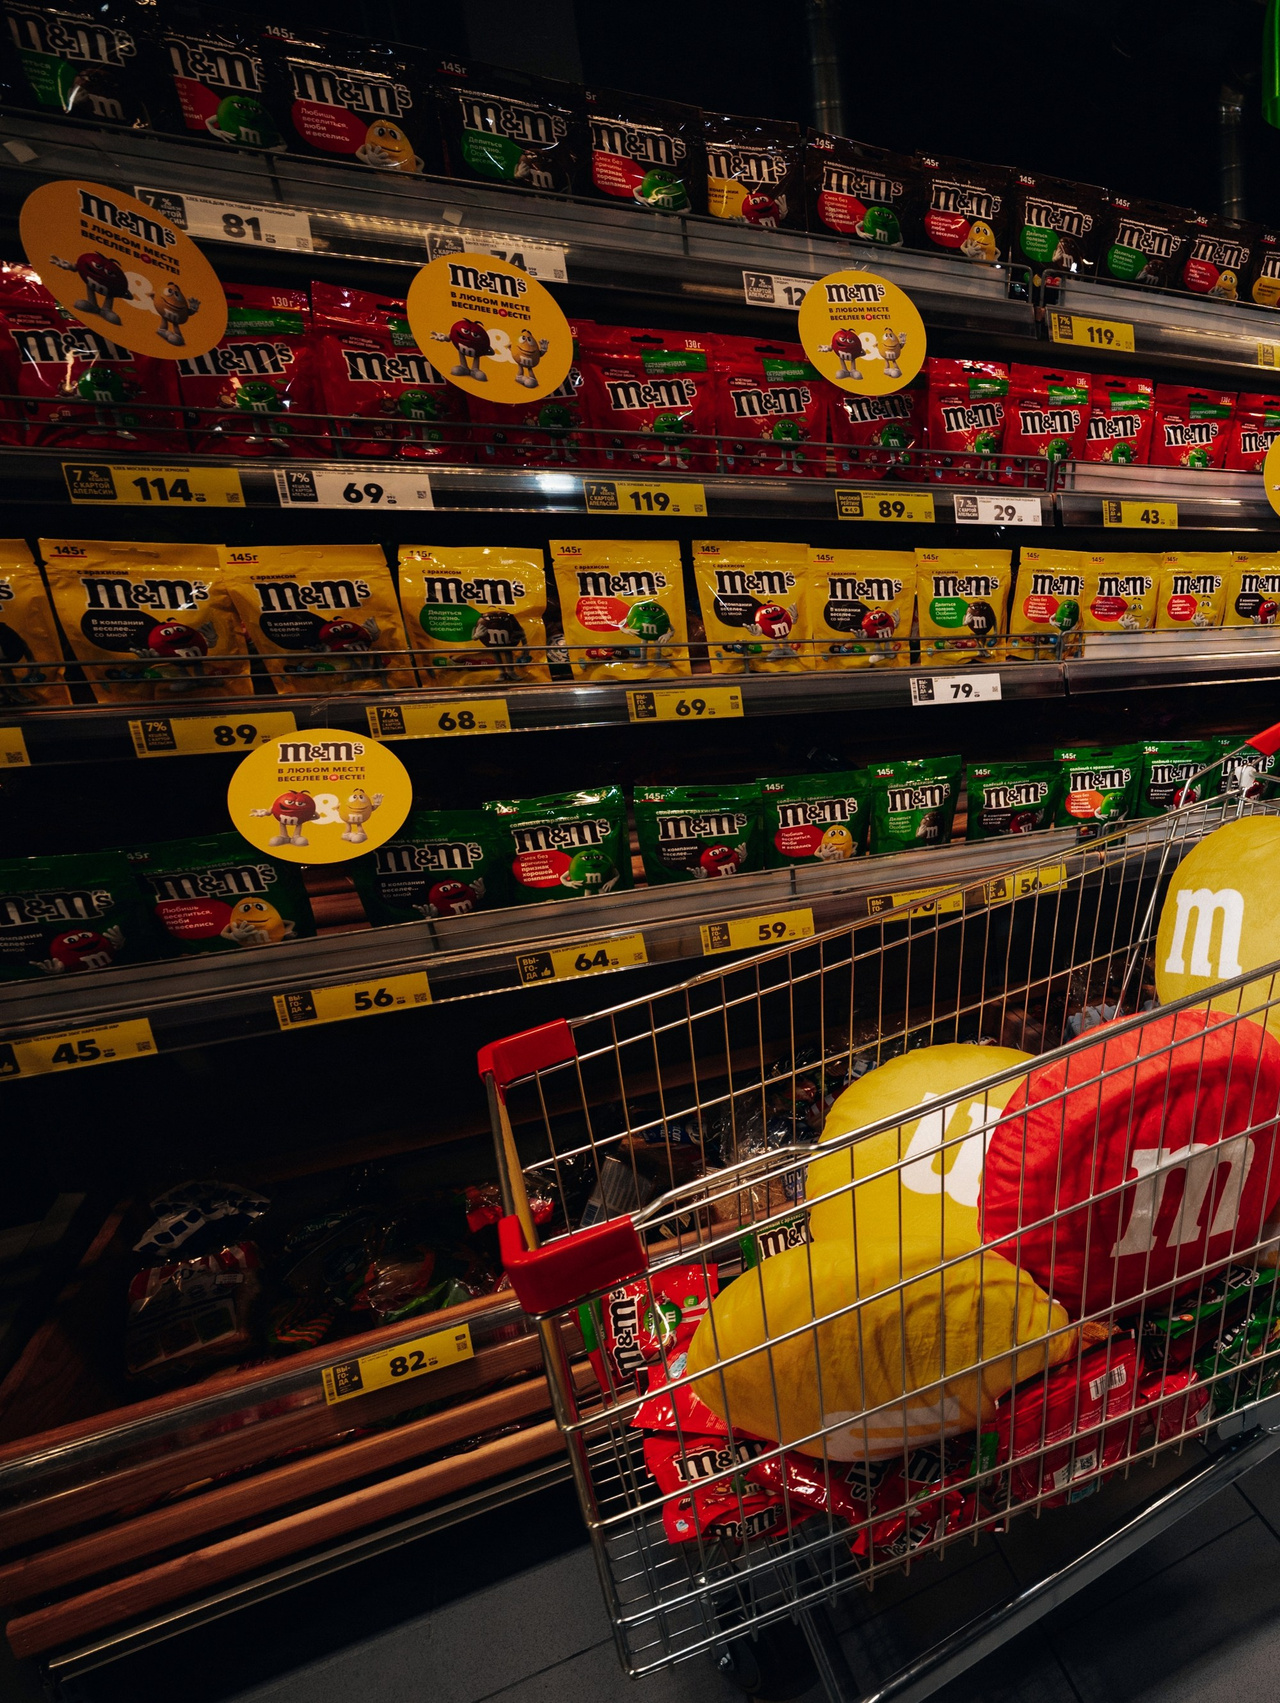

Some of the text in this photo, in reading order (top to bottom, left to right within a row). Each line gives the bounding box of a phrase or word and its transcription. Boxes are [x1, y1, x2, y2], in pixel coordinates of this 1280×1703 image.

[265, 25, 295, 40] 145г
[441, 60, 467, 75] 145г
[288, 62, 413, 118] m&m's
[301, 108, 336, 120] Любишь
[459, 95, 567, 145] m&m's
[304, 122, 328, 133] люби
[313, 131, 350, 142] веселись
[468, 136, 503, 149] Делиться
[589, 119, 687, 167] m&m's
[822, 166, 903, 203] m&m's
[1019, 174, 1036, 186] 145г
[930, 184, 1002, 220] m&m's
[1114, 198, 1131, 209] 145г
[78, 188, 177, 249] m&m's
[222, 213, 262, 241] 81
[1025, 201, 1094, 238] m&m's
[81, 229, 132, 256] ВЕСЕЛЕЕ
[91, 224, 142, 250] ЛЮБОМ
[144, 245, 180, 267] МЕСТЕ
[1115, 222, 1183, 259] m&m's
[1190, 239, 1250, 269] m&m's
[448, 263, 527, 299] m&m's
[460, 293, 499, 307] ЛЮБОМ
[501, 300, 531, 313] МЕСТЕ
[824, 283, 886, 304] m&m's
[451, 300, 491, 314] ВЕСЕЛЕЕ
[1087, 326, 1114, 345] 119
[606, 378, 697, 410] m&m's
[731, 387, 811, 418] m&m's
[844, 396, 914, 423] m&m's
[942, 402, 1003, 433] m&m's
[1018, 409, 1081, 435] m&m's
[1164, 422, 1218, 447] m&m's
[72, 470, 99, 481] 7 %
[79, 481, 110, 489] КАРТОЙ
[289, 472, 310, 483] 7%
[132, 477, 193, 501] 114
[343, 483, 384, 503] 69
[629, 491, 670, 511] 119
[879, 500, 905, 518] 89
[993, 504, 1016, 521] 29
[1140, 510, 1160, 525] 43
[54, 546, 86, 556] 145г
[230, 553, 258, 562] 145г
[560, 546, 581, 554] 145г
[423, 576, 526, 606] m&m's
[576, 571, 666, 597] m&m's
[714, 570, 796, 595] m&m's
[827, 577, 902, 601] m&m's
[932, 574, 998, 598] m&m's
[1098, 576, 1152, 597] m&m's
[1172, 574, 1221, 595] m&m's
[80, 578, 209, 610] m&m's
[254, 579, 371, 612] m&m's
[950, 683, 973, 698] 79
[380, 708, 398, 718] 7%
[675, 699, 706, 716] 69
[146, 721, 167, 732] 7%
[438, 710, 476, 731] 68
[213, 724, 257, 746] 89
[277, 741, 365, 763] m&m's
[1061, 752, 1076, 760] 145г
[974, 768, 991, 776] 145г
[1070, 768, 1131, 793] m&m's
[887, 782, 950, 813] m&m's
[983, 782, 1048, 811] m&m's
[777, 798, 857, 829] m&m's
[511, 818, 611, 854] m&m's
[657, 813, 747, 841] m&m's
[374, 842, 484, 875] m&m's
[537, 853, 548, 861] без
[147, 863, 278, 902] m&m's
[522, 869, 553, 877] хорошей
[523, 874, 559, 883] компании!
[162, 905, 199, 914] Любишь
[759, 922, 786, 941] 59
[522, 957, 539, 966] ВЫ-
[524, 964, 538, 973] ГО-
[575, 949, 609, 971] 64
[526, 971, 538, 980] ДА
[354, 988, 394, 1011] 56
[52, 1039, 101, 1064] 45
[1110, 1137, 1254, 1258] m
[609, 1287, 648, 1378] m&m's
[336, 1366, 351, 1374] ВЫ-
[389, 1350, 427, 1377] 82
[337, 1372, 349, 1380] ГО-
